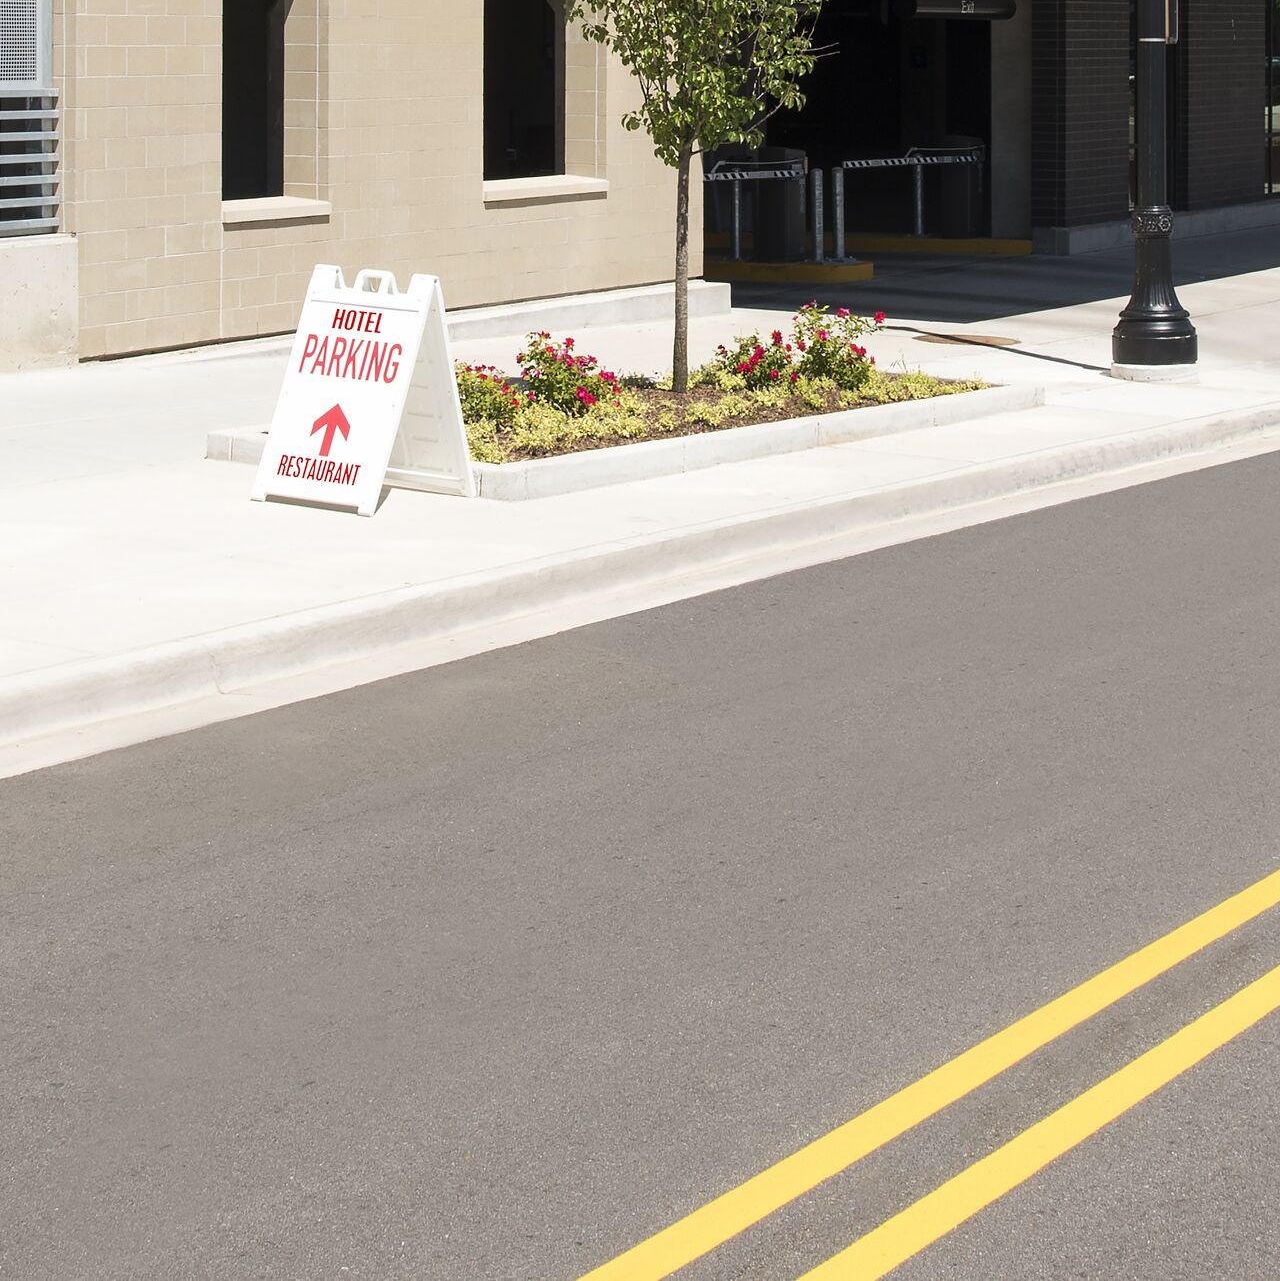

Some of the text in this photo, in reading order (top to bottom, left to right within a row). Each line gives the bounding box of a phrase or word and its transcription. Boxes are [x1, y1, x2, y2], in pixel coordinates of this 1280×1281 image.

[961, 0, 975, 14] Exit
[331, 308, 383, 334] HOTEL
[298, 333, 403, 384] PARKING
[277, 454, 362, 486] RESTAURANT
